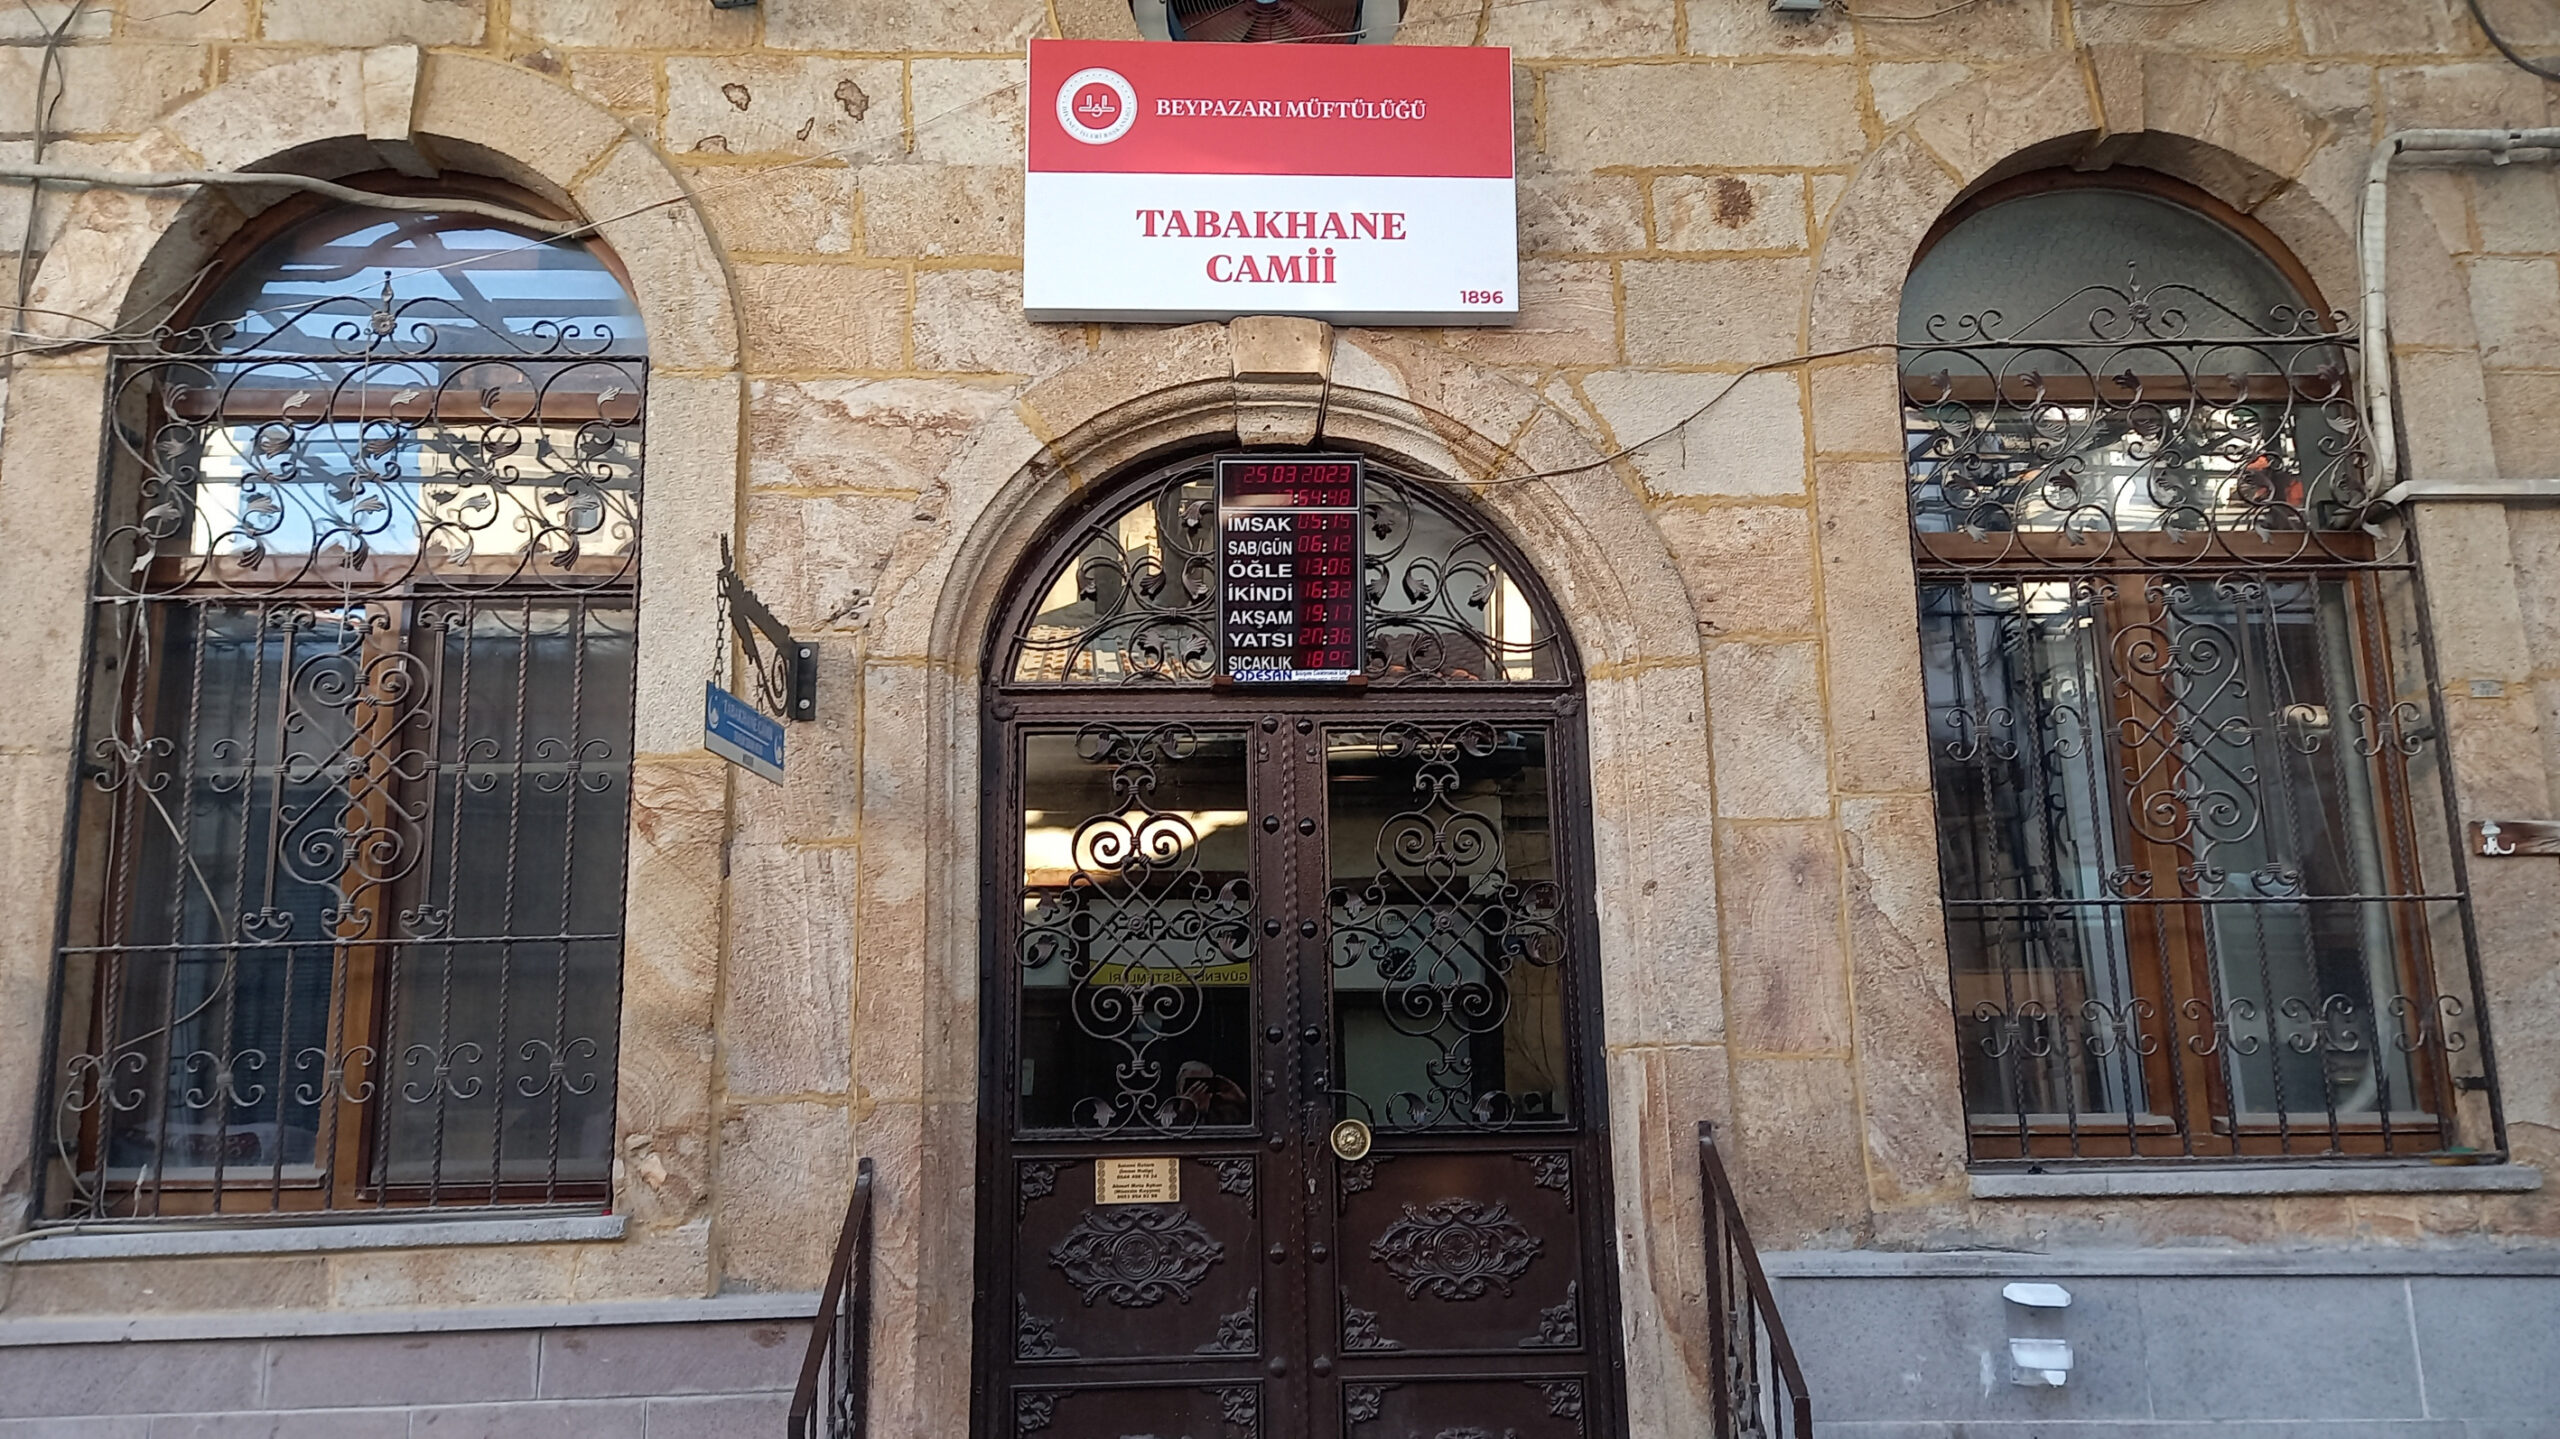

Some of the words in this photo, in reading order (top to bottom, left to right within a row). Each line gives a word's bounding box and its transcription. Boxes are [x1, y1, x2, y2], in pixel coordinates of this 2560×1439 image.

[1156, 98, 1284, 118] BEYPAZARI
[1286, 97, 1427, 120] MÜFTÜLÜĞÜ
[1136, 209, 1406, 240] TABAKHANE
[1206, 247, 1337, 283] CAMİİ
[1460, 290, 1504, 305] 1896
[1243, 465, 1267, 483] 25
[1272, 465, 1297, 483] 03
[1302, 465, 1351, 483] 2023
[1228, 515, 1292, 531] İMSAK
[1228, 538, 1293, 556] SAB/GÜN
[1298, 535, 1351, 553] 06:12
[1228, 560, 1292, 578] ÖĞLE
[1305, 558, 1351, 576] 13:06
[1228, 583, 1293, 602] İKİNDİ
[1305, 581, 1351, 599] 16:32
[1228, 610, 1293, 629] AKŞAM
[1305, 604, 1351, 622] 19:17
[1229, 633, 1293, 648] YATSI
[1228, 655, 1293, 670] SICAKLIK
